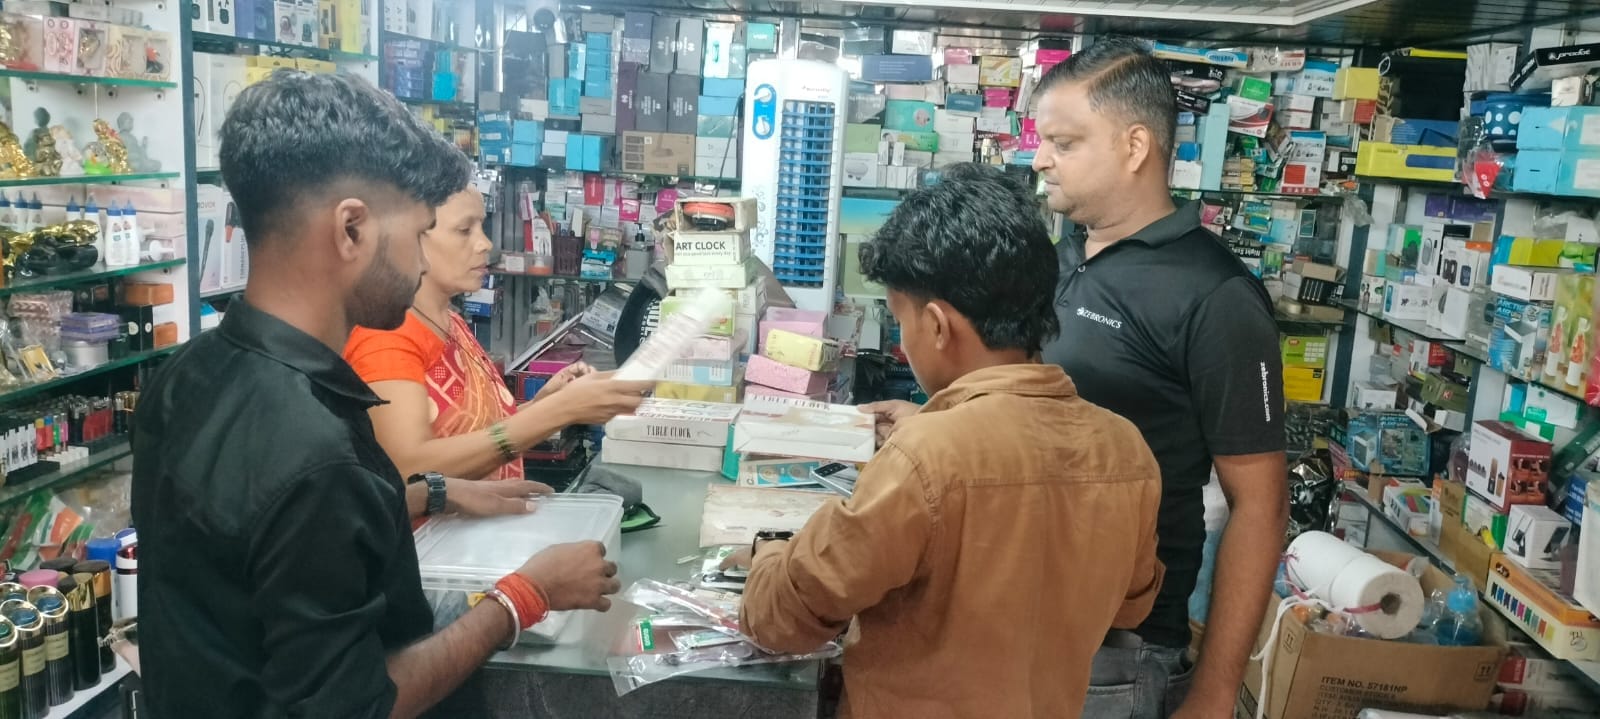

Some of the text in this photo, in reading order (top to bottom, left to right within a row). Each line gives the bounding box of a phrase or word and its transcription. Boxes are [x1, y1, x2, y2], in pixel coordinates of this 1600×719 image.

[675, 241, 726, 251] ART CLOCK
[1083, 309, 1123, 329] ZEBRONICS
[1260, 361, 1271, 422] zebronics.com
[647, 424, 692, 439] TABLE CLOCK
[1321, 676, 1346, 686] ITEM
